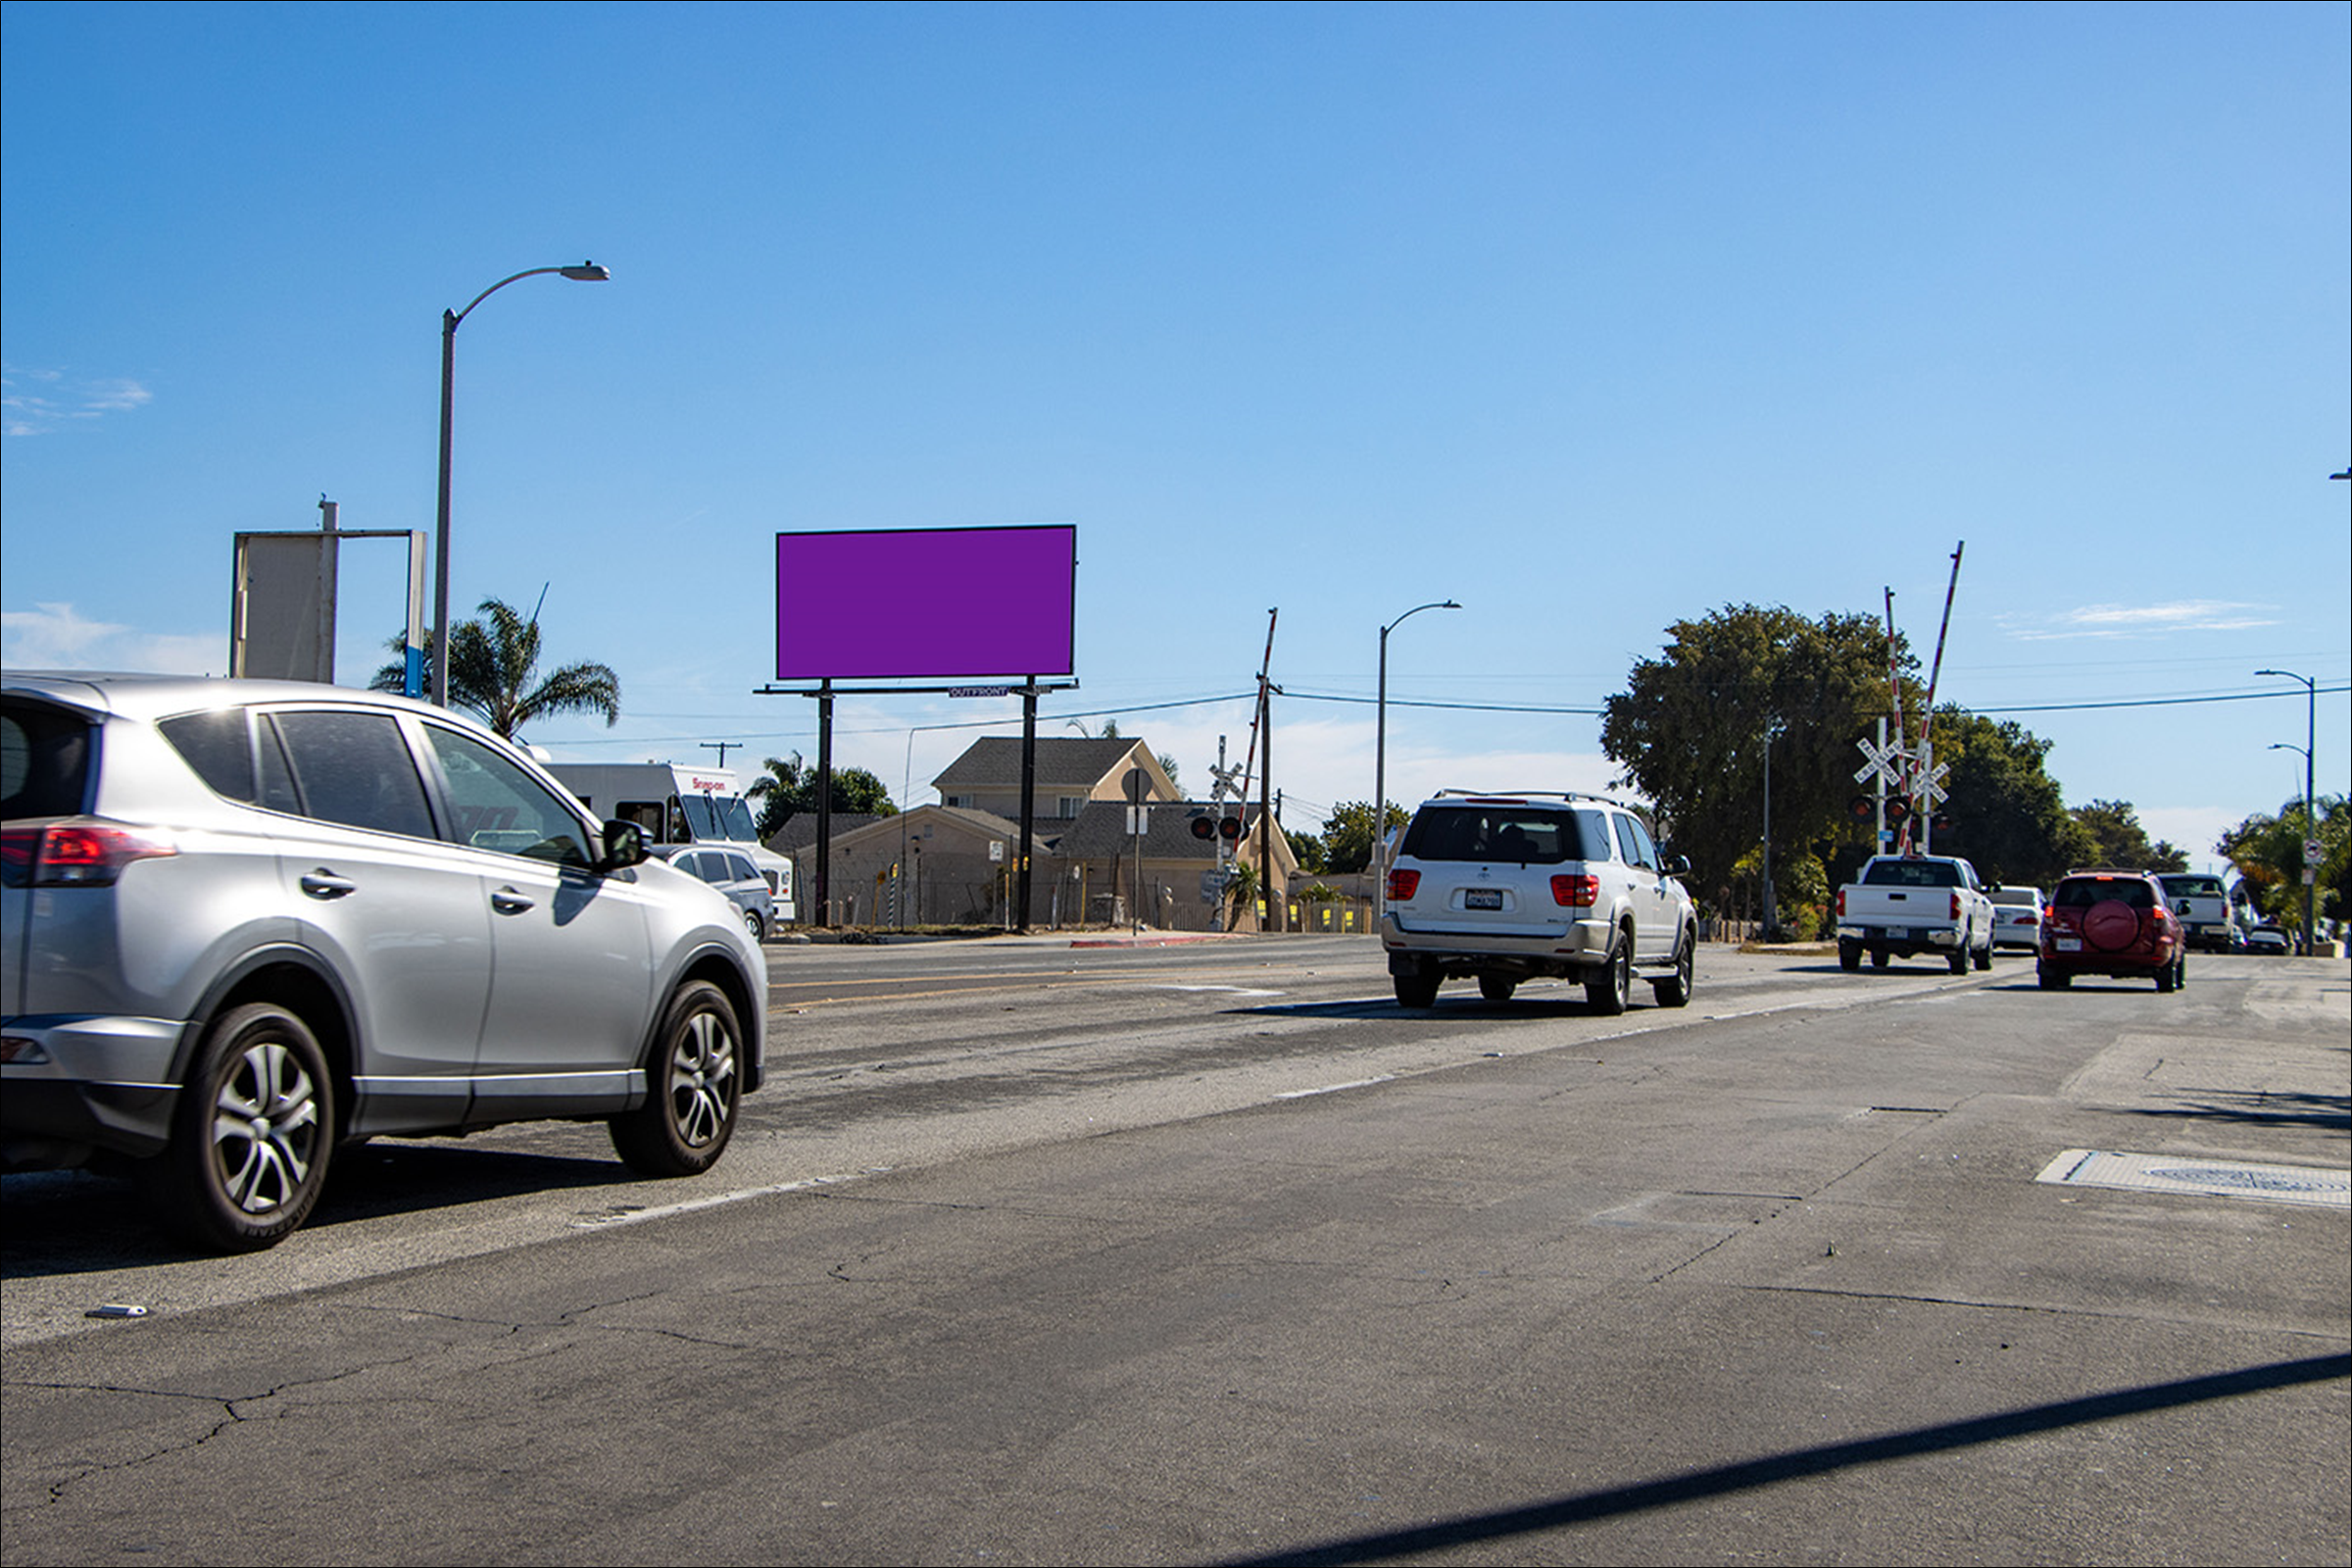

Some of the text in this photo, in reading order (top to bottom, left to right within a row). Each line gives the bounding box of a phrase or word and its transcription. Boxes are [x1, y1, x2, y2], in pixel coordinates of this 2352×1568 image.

[951, 687, 1006, 697] OUTFRONT
[1856, 741, 1901, 781] CROSSING
[1859, 740, 1897, 783] RAILROAD
[692, 777, 725, 791] Snap-on
